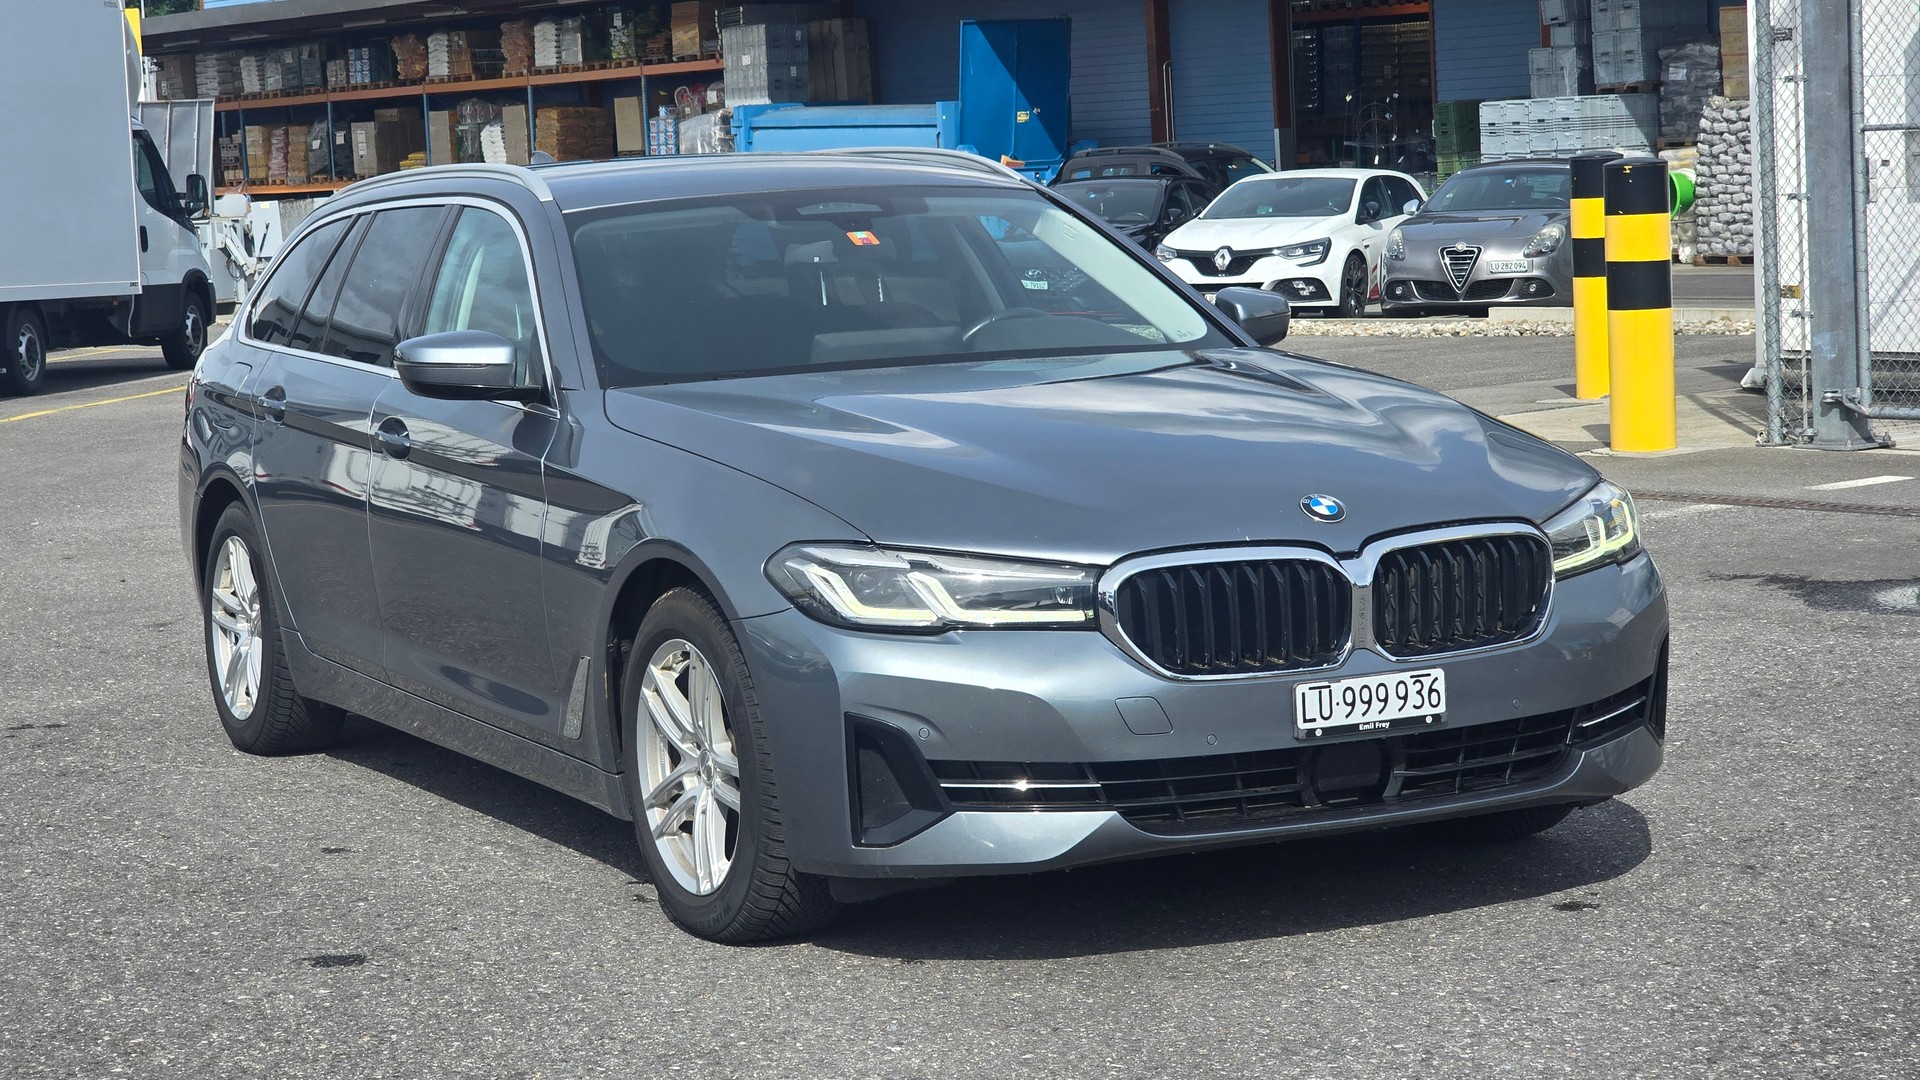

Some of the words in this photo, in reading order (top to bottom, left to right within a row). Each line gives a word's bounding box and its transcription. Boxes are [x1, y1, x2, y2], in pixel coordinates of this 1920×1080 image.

[1396, 676, 1441, 713] 936
[1359, 722, 1374, 731] Emil
[1375, 721, 1391, 730] Frey
